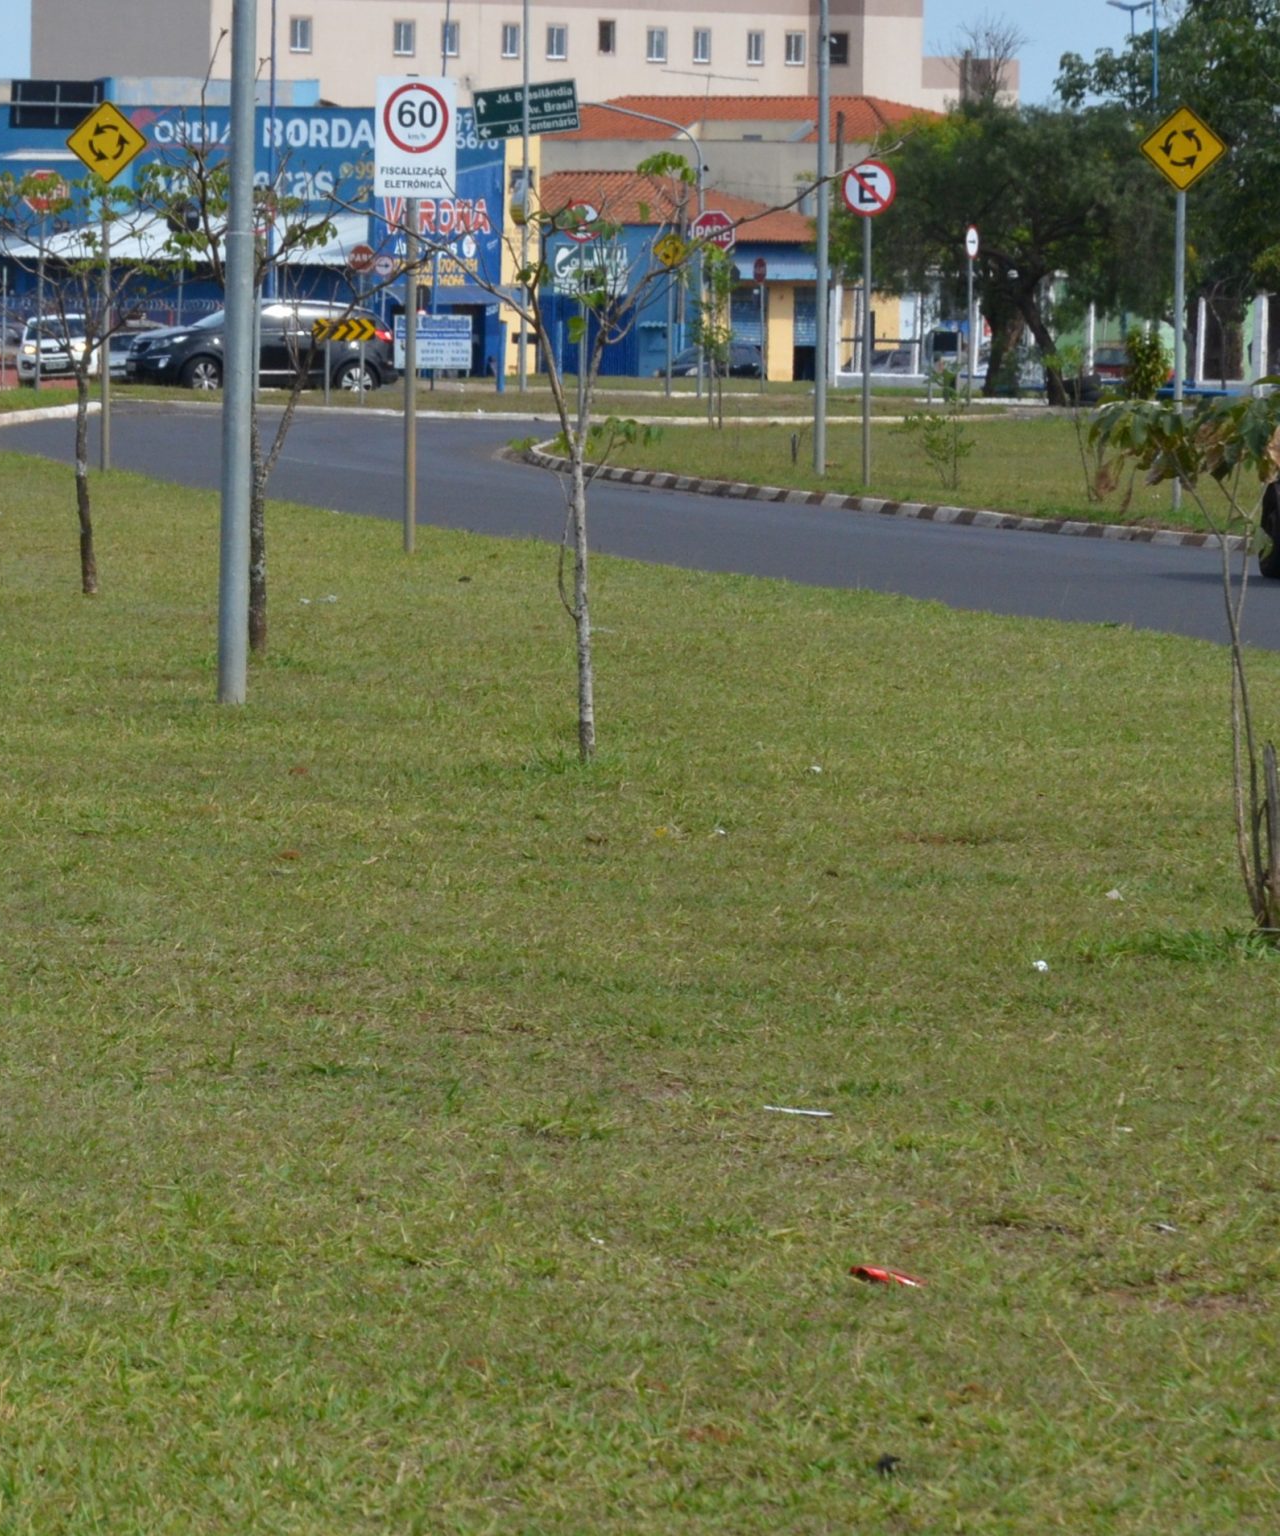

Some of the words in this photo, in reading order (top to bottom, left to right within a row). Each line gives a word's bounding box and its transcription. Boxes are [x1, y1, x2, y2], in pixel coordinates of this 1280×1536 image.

[495, 93, 512, 104] Jd.
[514, 86, 573, 102] Basilândia
[397, 100, 438, 128] 60
[544, 99, 574, 113] Brasil
[506, 124, 521, 134] Jd.
[527, 117, 577, 132] entenário
[379, 164, 447, 177] FISCALIZAÇÃO
[383, 178, 443, 190] ELETRÔNICA
[858, 172, 878, 203] E
[383, 197, 491, 235] VRONA
[695, 225, 731, 241] PARE
